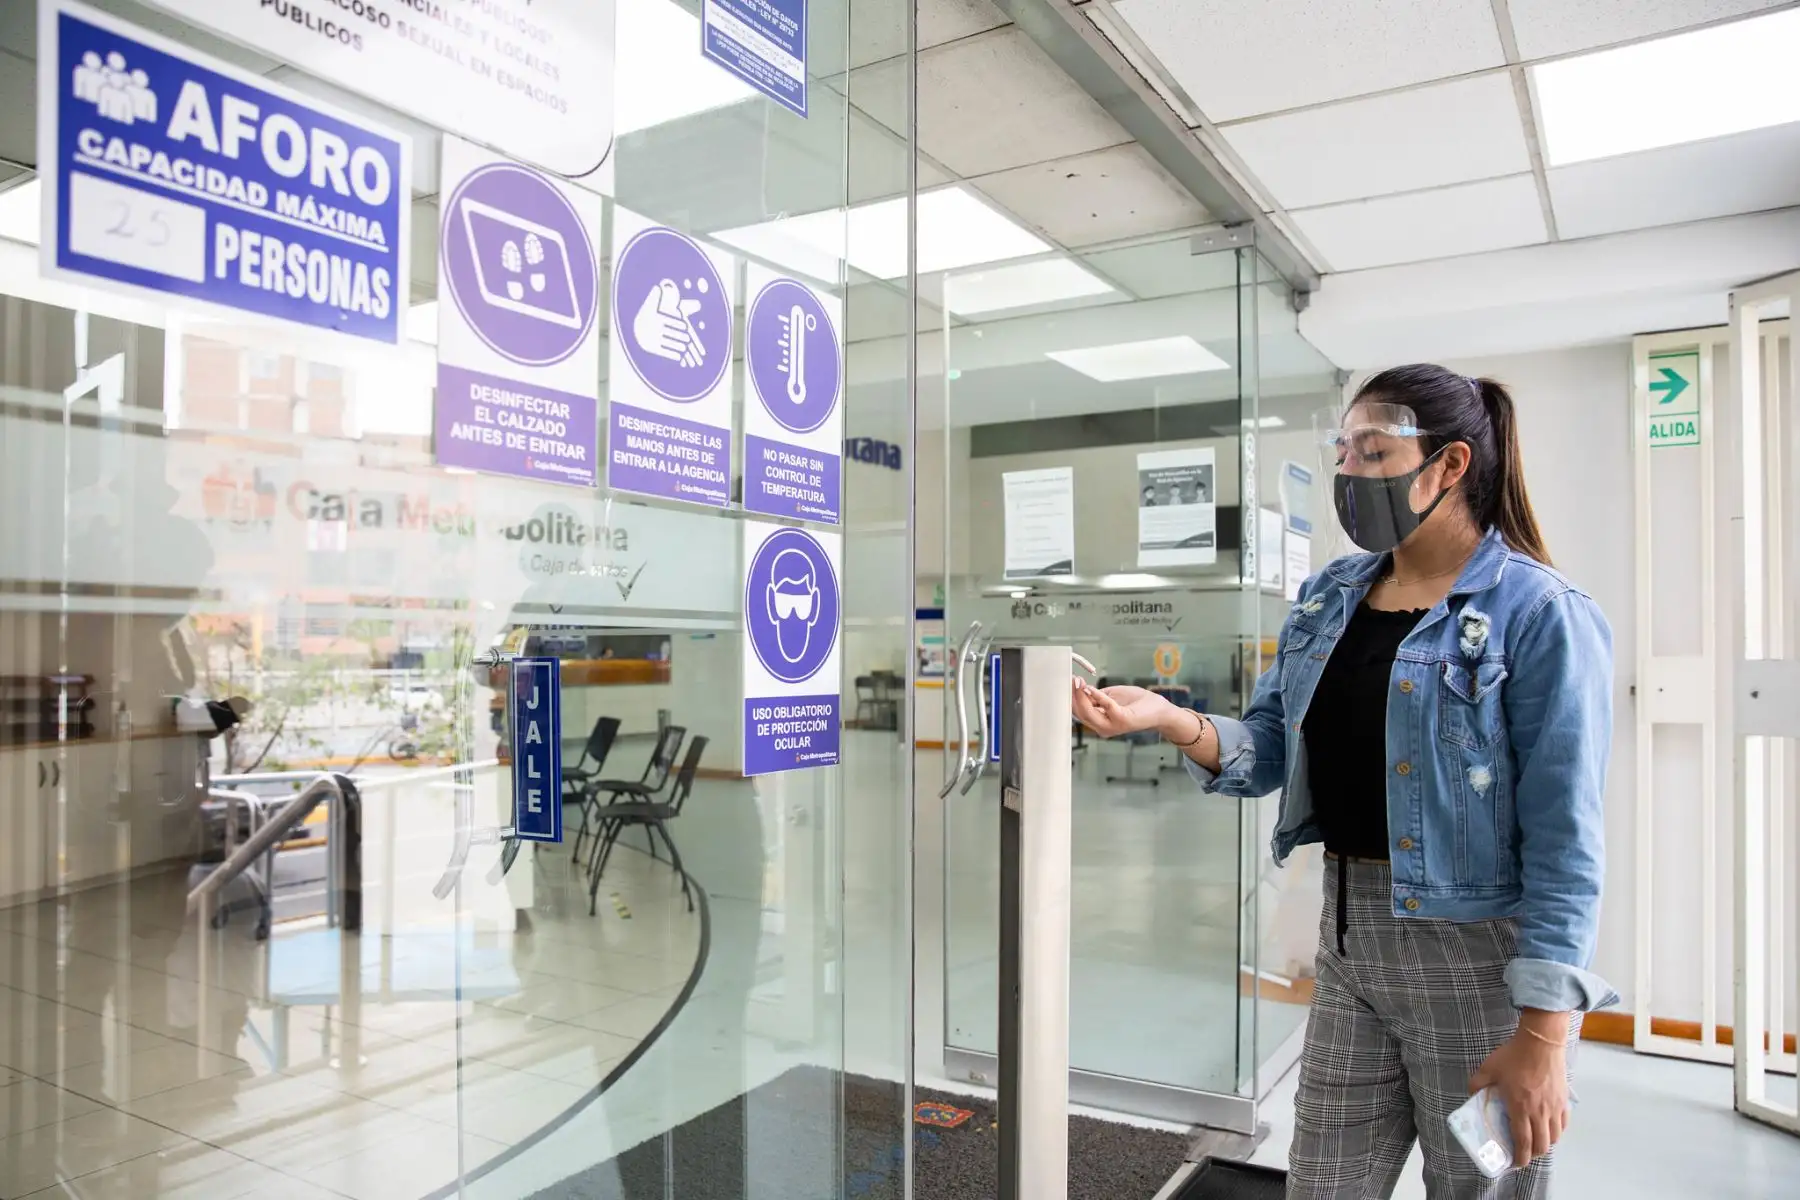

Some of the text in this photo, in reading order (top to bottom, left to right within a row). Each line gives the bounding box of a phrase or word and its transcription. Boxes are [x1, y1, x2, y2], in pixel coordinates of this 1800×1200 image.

[167, 79, 391, 206] AFORO
[78, 128, 387, 245] CAPACIDAD MÁXIMA
[103, 198, 171, 247] 25
[214, 221, 391, 320] PERSONAS
[470, 383, 570, 419] DESINFECTAR
[475, 405, 566, 438] EL CALZADO
[618, 414, 722, 450] DESINFECTARSE LAS
[1649, 421, 1696, 438] ALIDA
[450, 422, 586, 461] ANTES DE ENTRAR
[626, 434, 715, 465] MANOS ANTES DE
[613, 450, 726, 484] ENTRAR A LA AGENCIA
[763, 448, 824, 472] NO PASAR SIN
[765, 466, 822, 487] CONTROL DE
[760, 481, 826, 504] TEMPERATURA
[396, 493, 629, 552] Metrolitana
[753, 704, 832, 720] USO OBLIGATORIO
[757, 717, 828, 736] DE PROTECCIÓN
[525, 685, 543, 814] JALE
[774, 736, 811, 751] OCULAR
